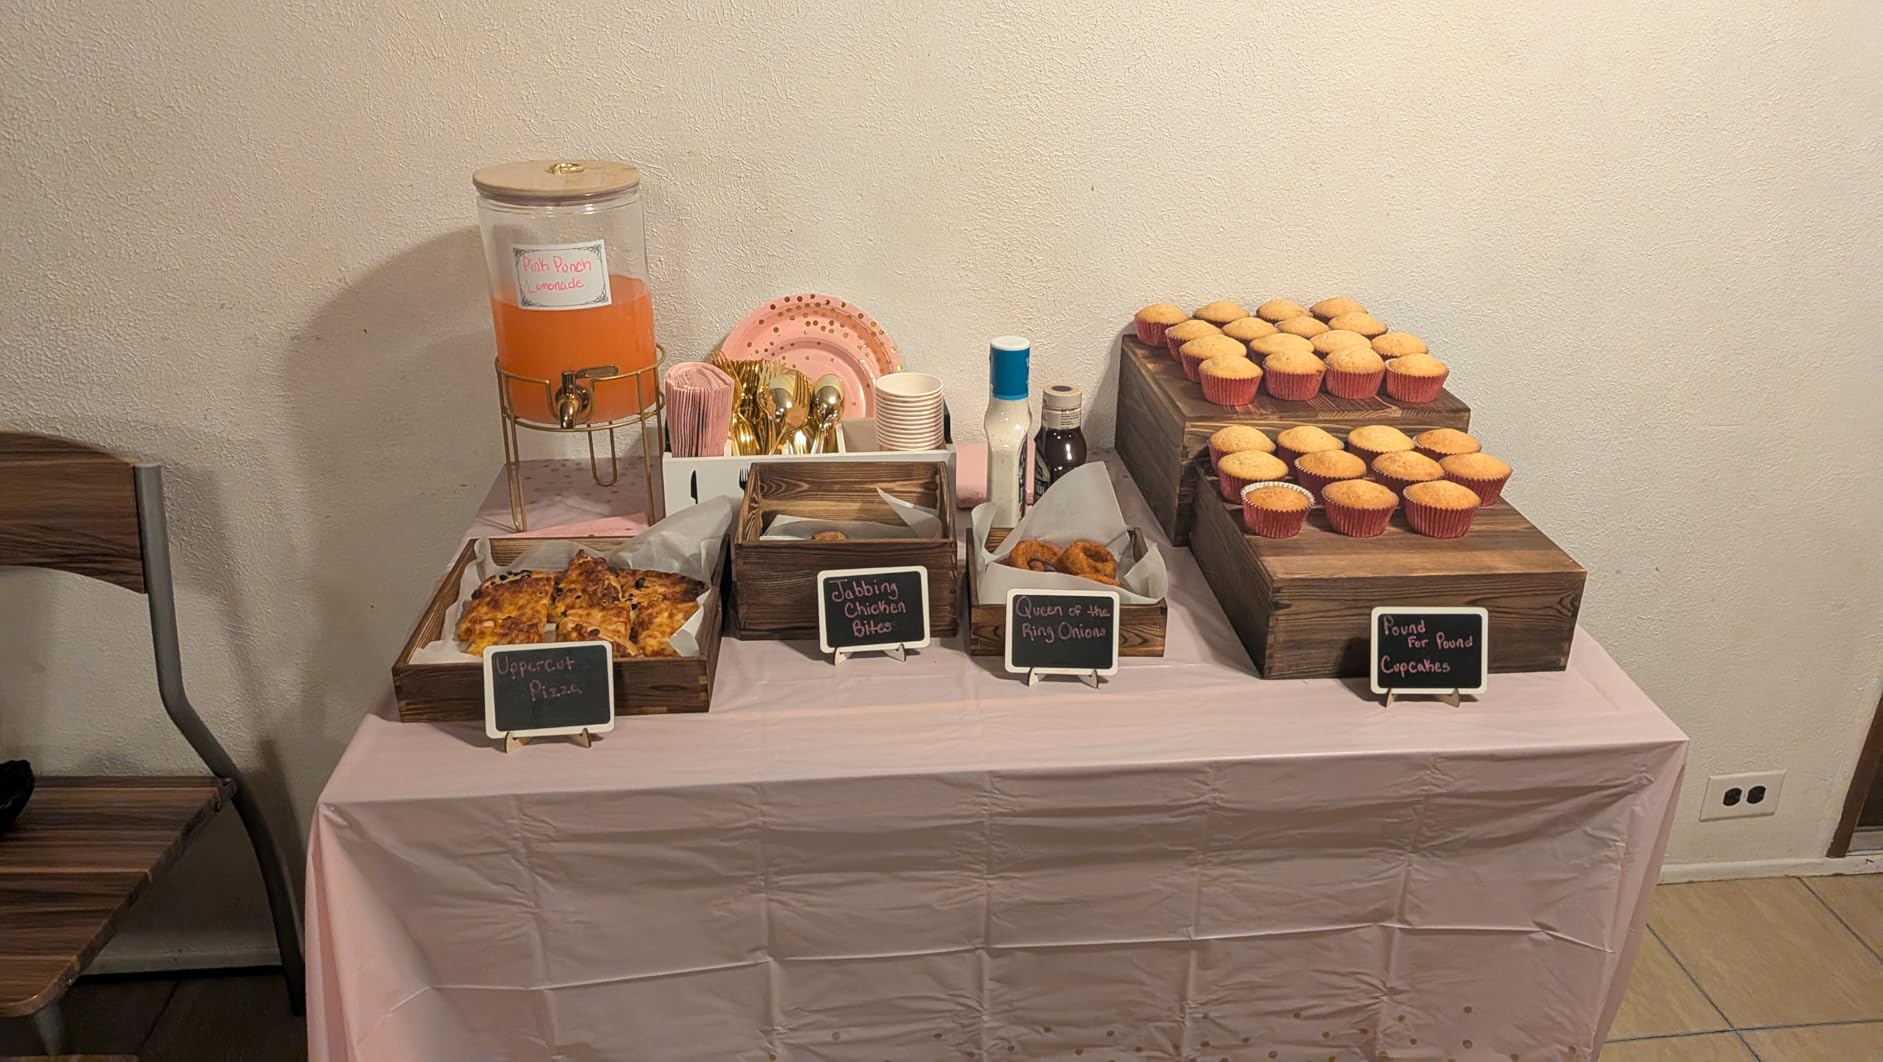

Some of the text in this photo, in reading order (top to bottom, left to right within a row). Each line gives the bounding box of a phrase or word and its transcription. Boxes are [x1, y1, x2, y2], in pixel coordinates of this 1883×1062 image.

[523, 255, 592, 272] Pink Punch
[526, 276, 585, 293] Lemonade
[828, 578, 899, 602] Jabbing
[844, 600, 907, 618] Chicken
[1015, 595, 1111, 619] Queen of the
[852, 619, 893, 638] Bites
[1022, 621, 1107, 644] Ring Onions
[1383, 615, 1426, 636] Pound
[1407, 631, 1473, 650] For Pound
[1380, 655, 1451, 678] Cupcakes
[529, 679, 583, 702] Pizza
